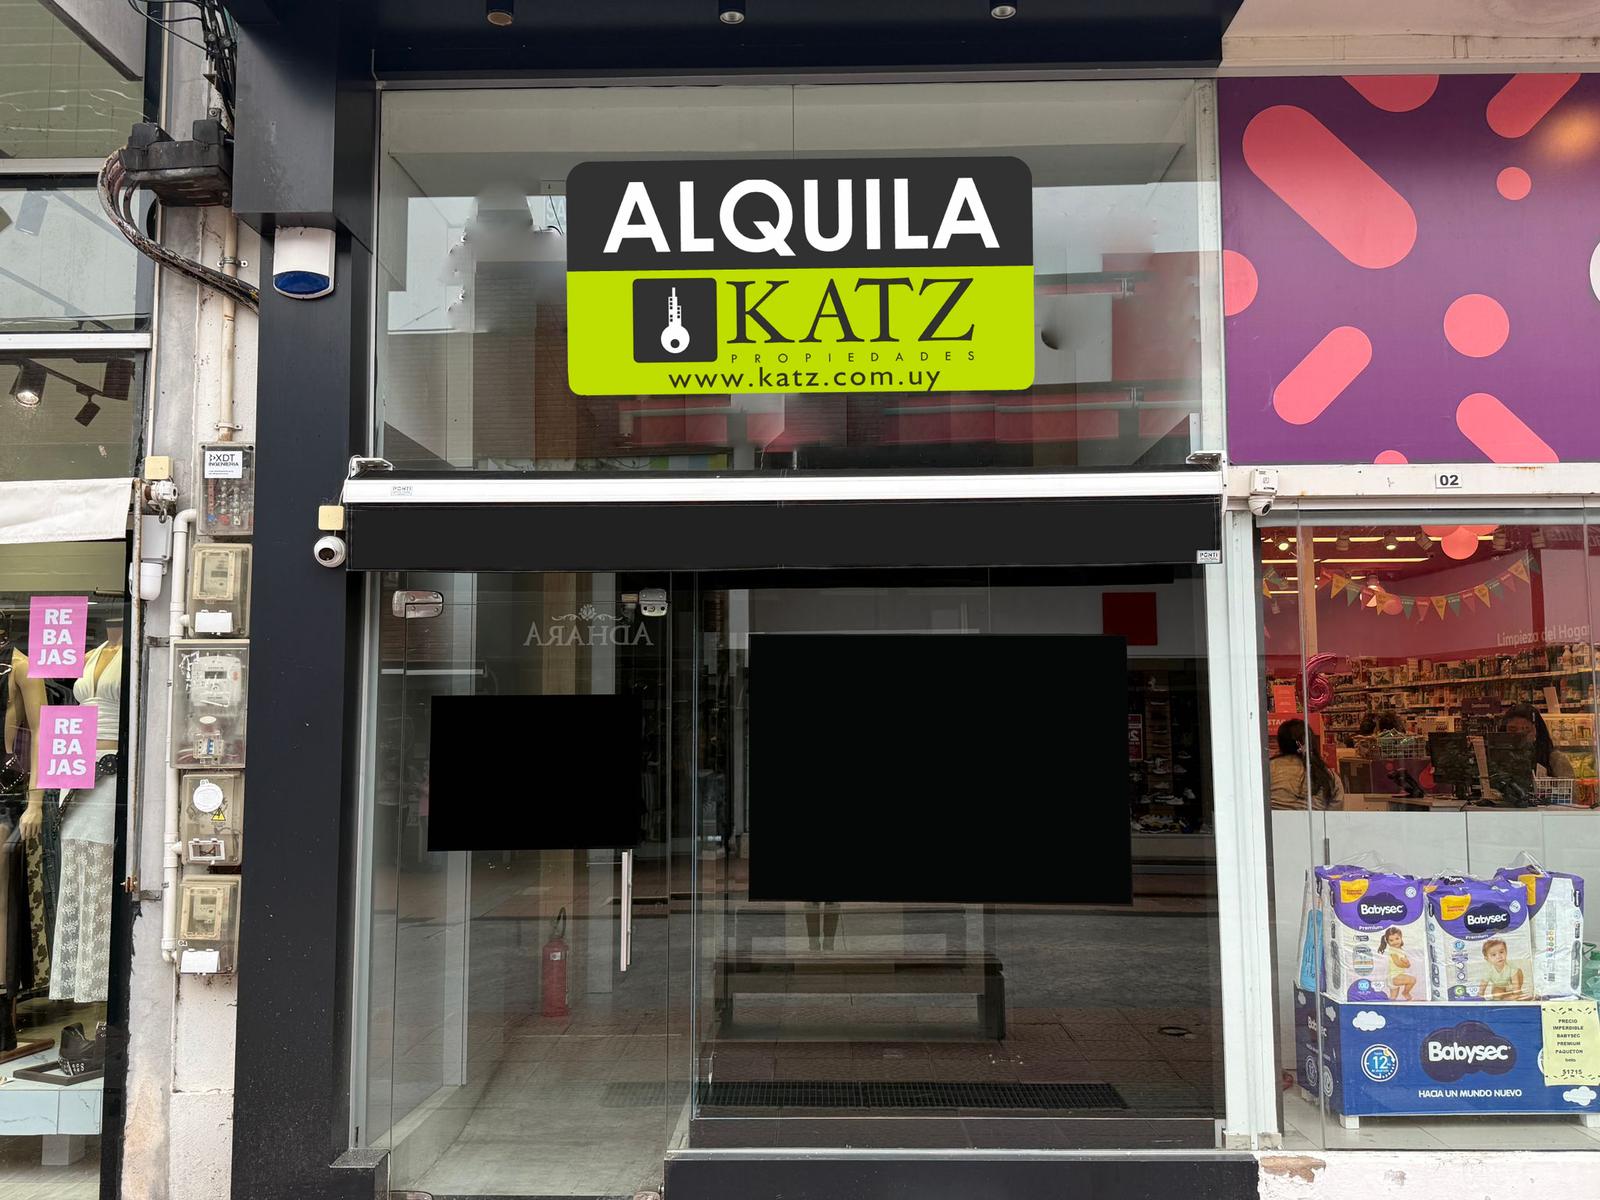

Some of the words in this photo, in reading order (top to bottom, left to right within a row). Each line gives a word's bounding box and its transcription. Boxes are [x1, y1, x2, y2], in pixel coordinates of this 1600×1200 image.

[603, 177, 1000, 257] ALQUILA
[726, 277, 975, 344] KATZ
[730, 350, 975, 364] PROPIEDADES
[668, 366, 941, 391] www.katz.com.uy
[1439, 474, 1460, 486] 02
[44, 608, 73, 625] RE
[42, 628, 73, 645] BA
[1497, 630, 1539, 648] Limpieza
[1541, 626, 1556, 641] del
[37, 648, 77, 666] JAS
[54, 718, 84, 735] RE
[52, 738, 83, 755] BA
[46, 758, 87, 776] JAS
[1360, 903, 1404, 915] Babysec
[1467, 912, 1508, 926] Babysec
[1428, 1041, 1509, 1064] Babysec
[1373, 1056, 1388, 1069] 12
[1418, 1090, 1444, 1098] HACIA
[1460, 1089, 1493, 1097] MUNDO
[1493, 1089, 1522, 1097] NUEVO
